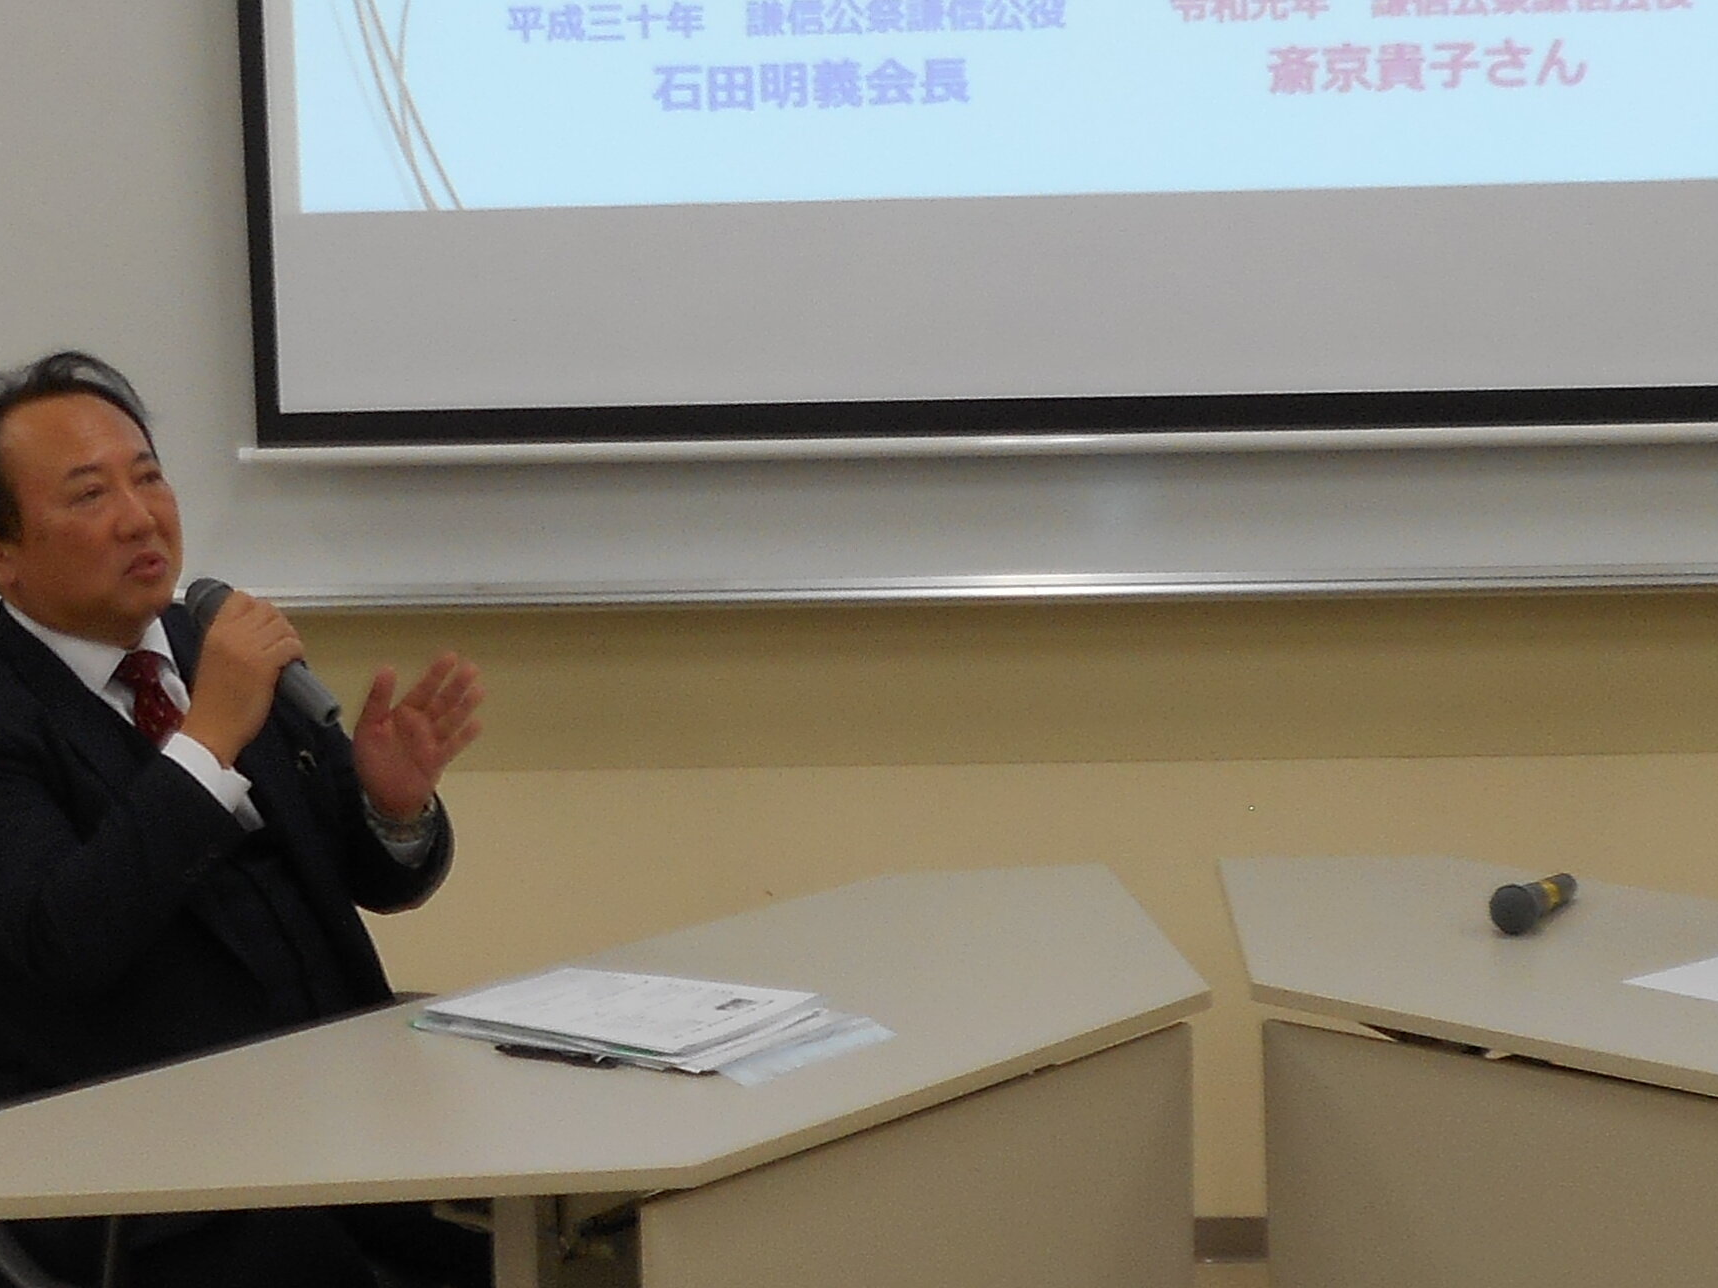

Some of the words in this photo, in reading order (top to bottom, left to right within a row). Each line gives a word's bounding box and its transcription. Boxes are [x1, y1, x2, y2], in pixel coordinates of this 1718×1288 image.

[507, 2, 705, 43] 平成三十年
[652, 58, 970, 112] 石田明義会長
